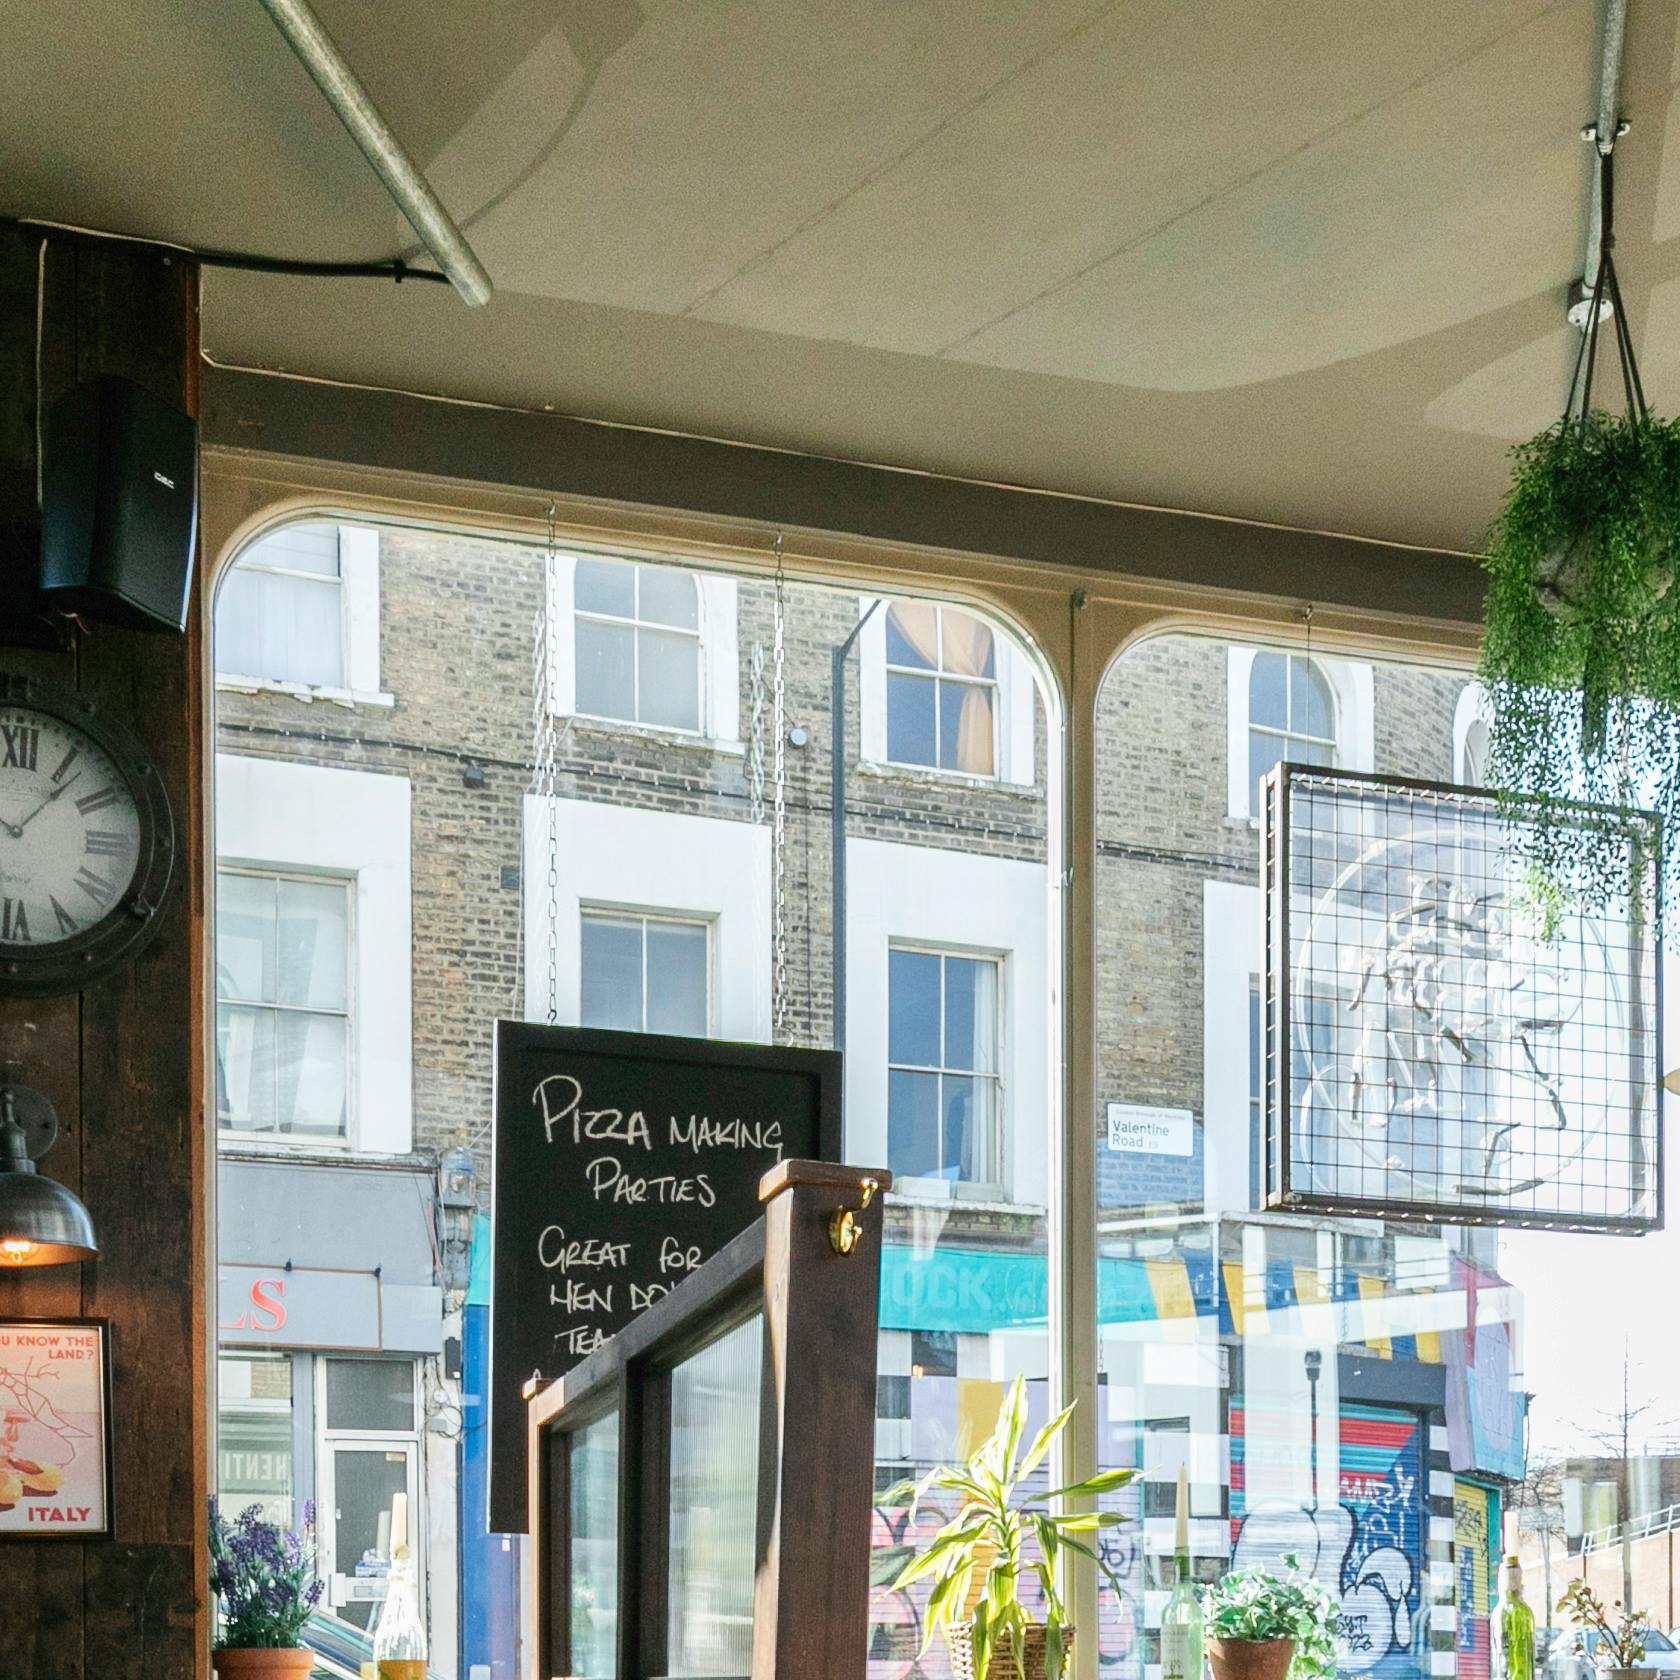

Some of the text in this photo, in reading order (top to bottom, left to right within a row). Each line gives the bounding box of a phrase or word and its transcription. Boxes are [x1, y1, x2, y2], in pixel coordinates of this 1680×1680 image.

[0, 724, 39, 772] XII
[76, 786, 117, 816] II
[85, 830, 131, 857] III
[1, 897, 32, 941] VI
[531, 1074, 652, 1151] PIZZA
[1112, 1119, 1170, 1136] Valentine
[1112, 1133, 1144, 1147] Road
[585, 1156, 717, 1208] PARTIES
[538, 1225, 631, 1273] GREAT
[550, 1280, 613, 1314] HEN
[16, 1335, 60, 1347] KNOW
[65, 1336, 94, 1348] THE
[554, 1325, 617, 1355] TEA
[27, 1506, 91, 1522] ITALY
